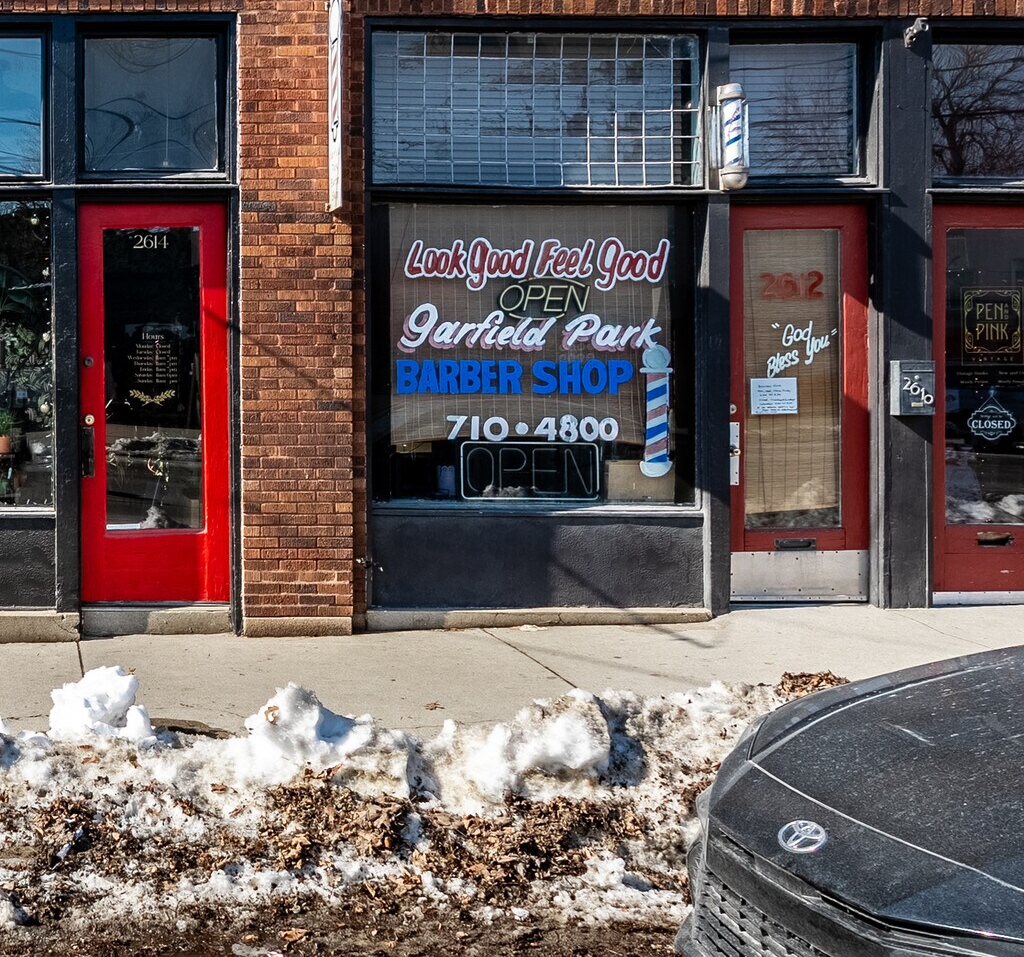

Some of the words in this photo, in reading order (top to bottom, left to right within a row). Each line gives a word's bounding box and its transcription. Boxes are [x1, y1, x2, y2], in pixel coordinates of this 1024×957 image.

[132, 234, 169, 249] 2614
[404, 239, 468, 279] Look
[533, 238, 595, 279] Feel
[499, 284, 590, 313] OPEN
[760, 270, 824, 300] 2612
[976, 303, 1004, 320] PEN
[141, 332, 165, 340] Hours
[397, 303, 556, 353] Garfield
[562, 313, 662, 352] Park
[976, 323, 1009, 340] PINK
[396, 359, 523, 395] BARBER
[532, 359, 635, 395] SHOP
[766, 349, 800, 379] Bless
[903, 377, 933, 404] 2610
[971, 419, 1011, 429] CLOSED
[466, 447, 593, 495] OPEN
